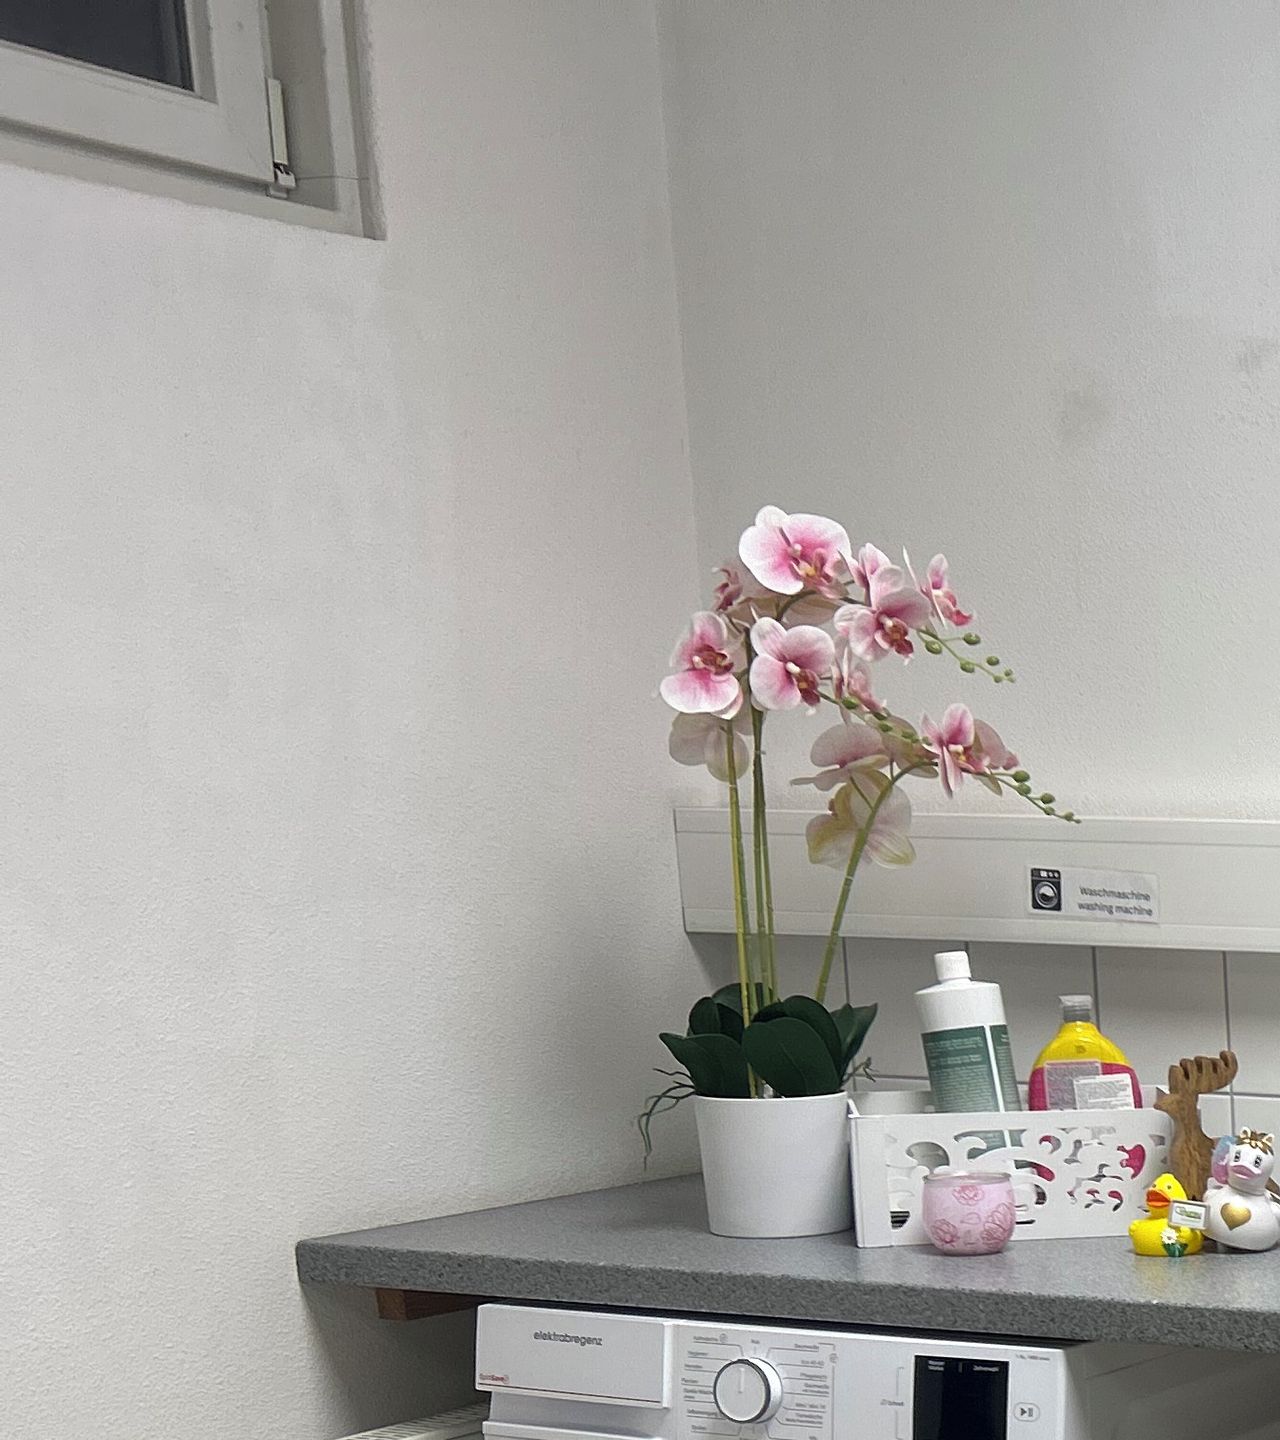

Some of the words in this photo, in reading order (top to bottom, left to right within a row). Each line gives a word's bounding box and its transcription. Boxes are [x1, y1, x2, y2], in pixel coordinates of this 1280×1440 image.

[1079, 886, 1151, 902] Waschmaschine
[1078, 902, 1114, 916] washing
[1116, 904, 1153, 916] machine
